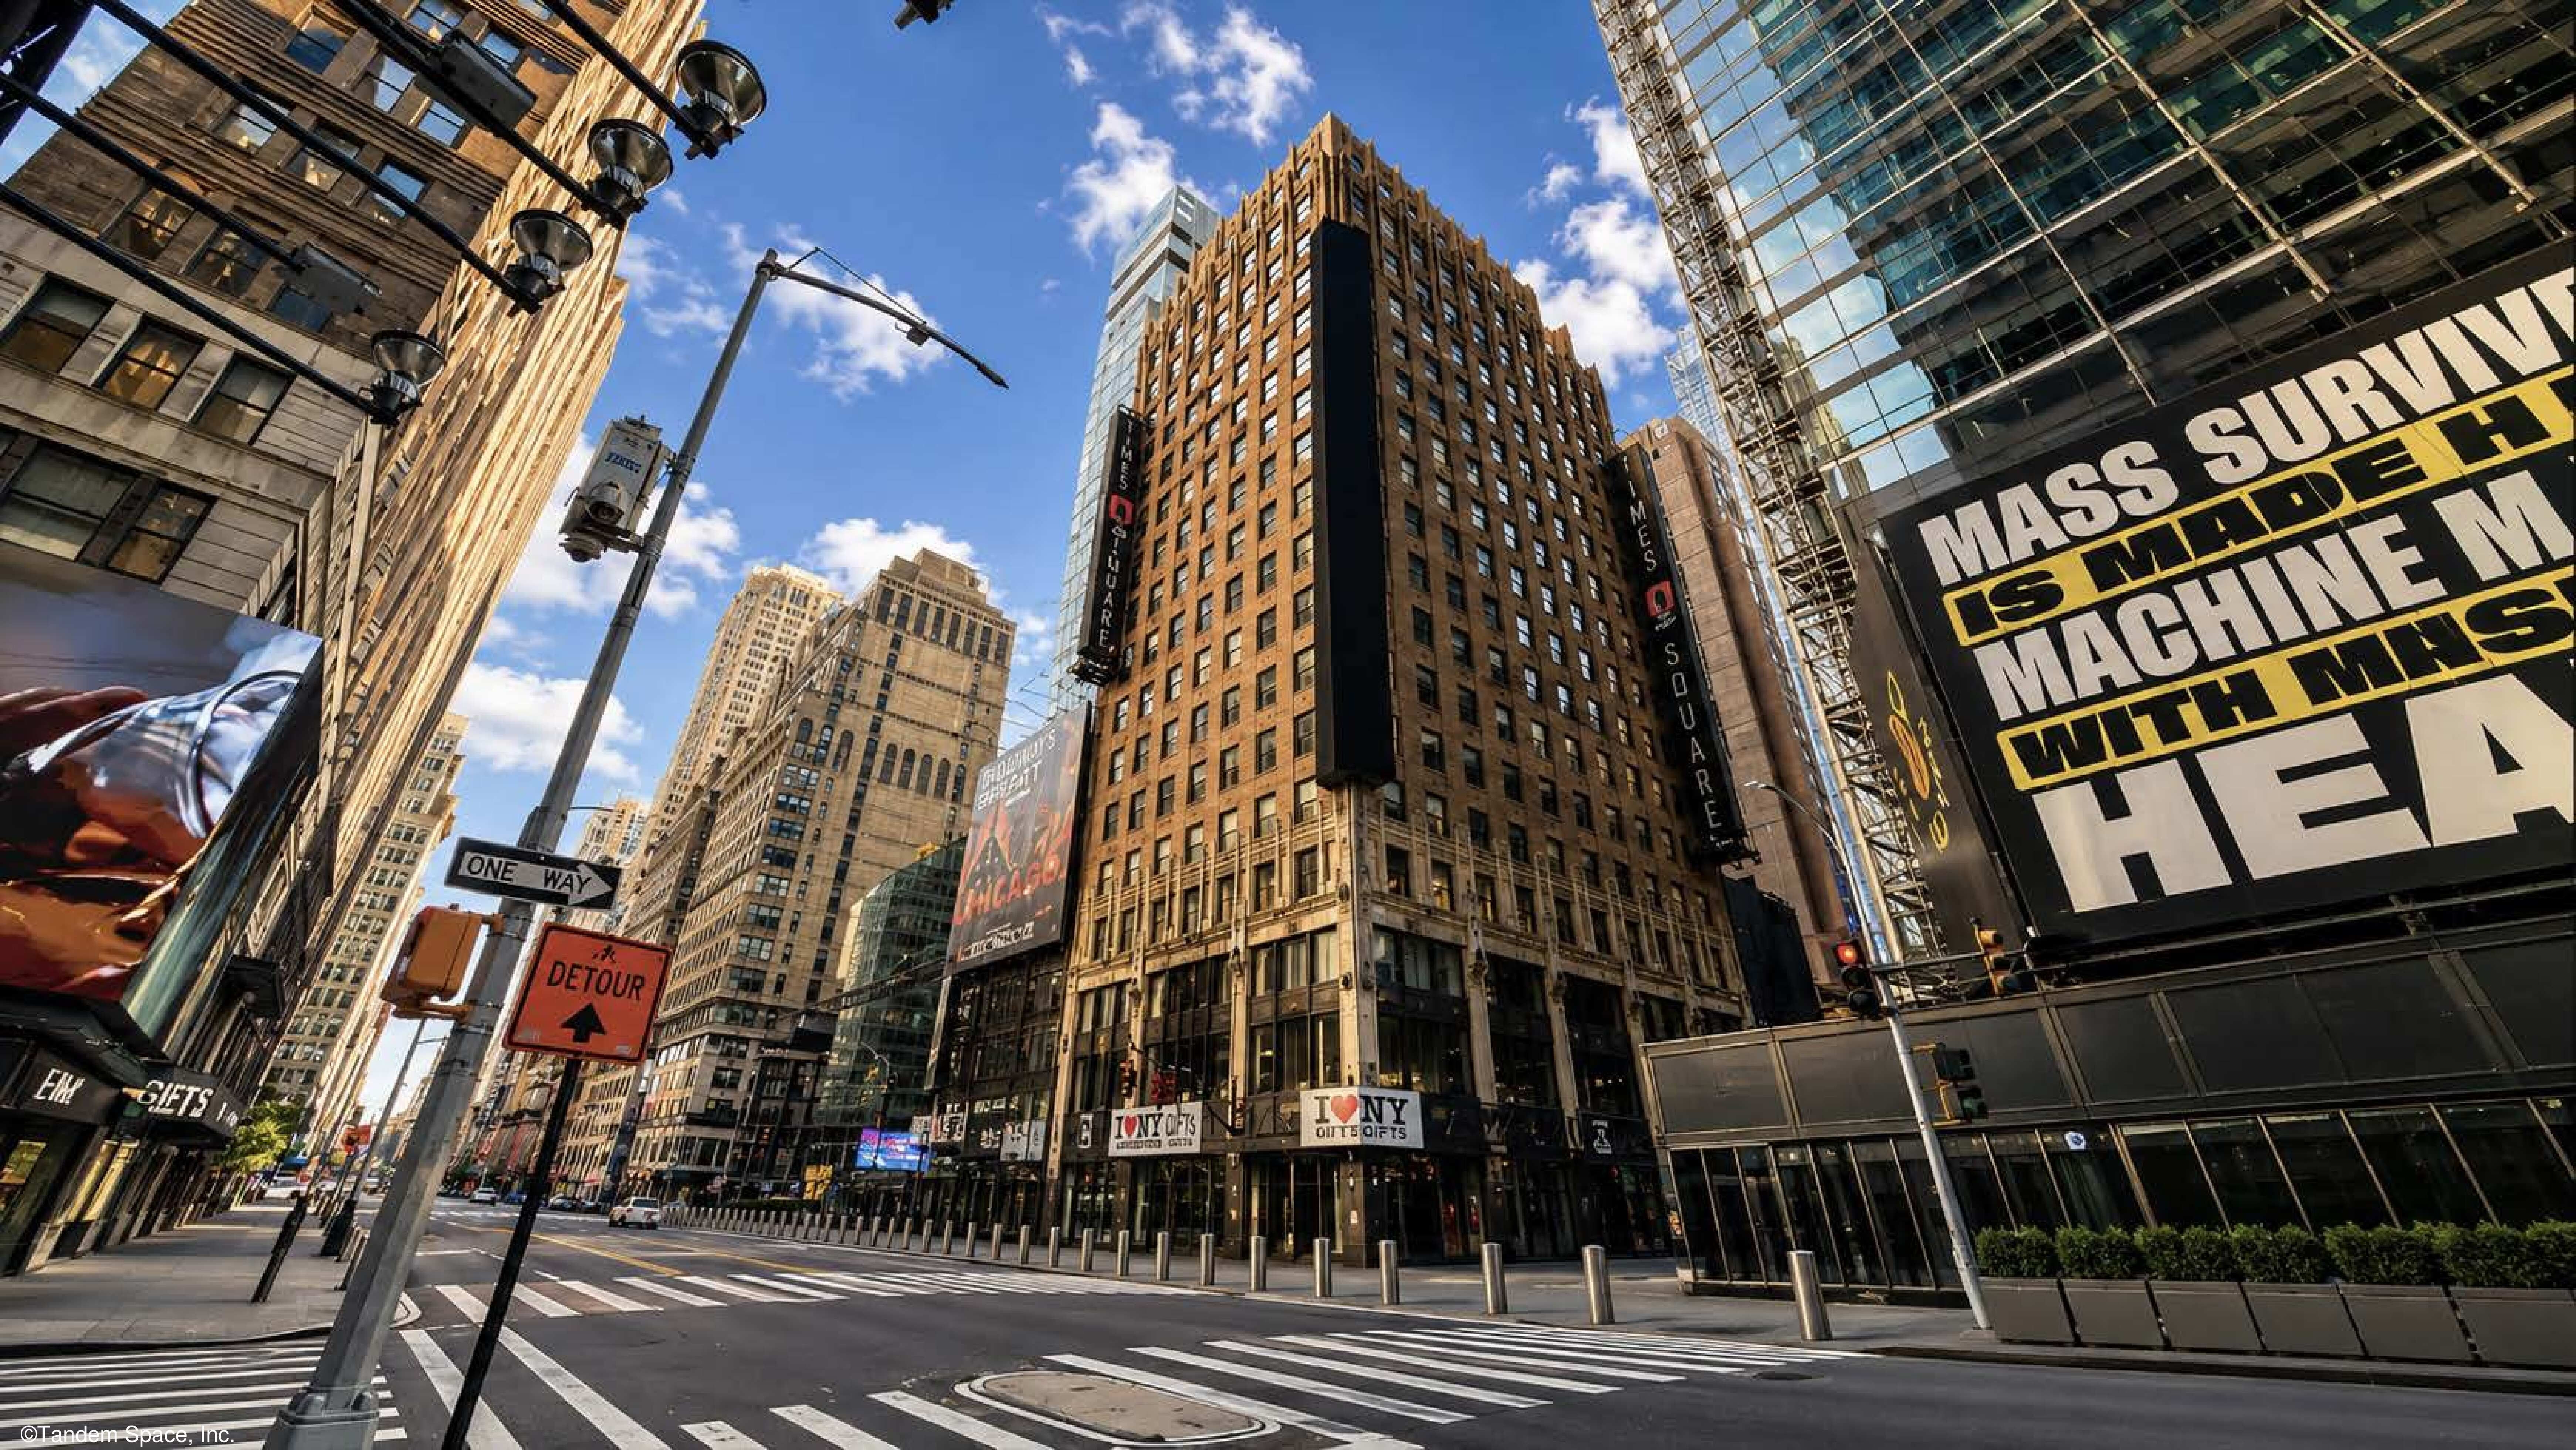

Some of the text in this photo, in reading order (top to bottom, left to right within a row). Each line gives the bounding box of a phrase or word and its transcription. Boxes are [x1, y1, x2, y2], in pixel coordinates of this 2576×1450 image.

[1918, 440, 2179, 587] MASS
[1954, 570, 2064, 638] IS
[2081, 437, 2427, 592] MADE
[1973, 513, 2448, 720] MACHINE
[1665, 643, 1722, 828] SQUARE
[2011, 668, 2276, 778] WITH
[2034, 673, 2574, 913] HEA
[468, 855, 592, 894] ONE WAY
[547, 961, 645, 1000] DETOUR
